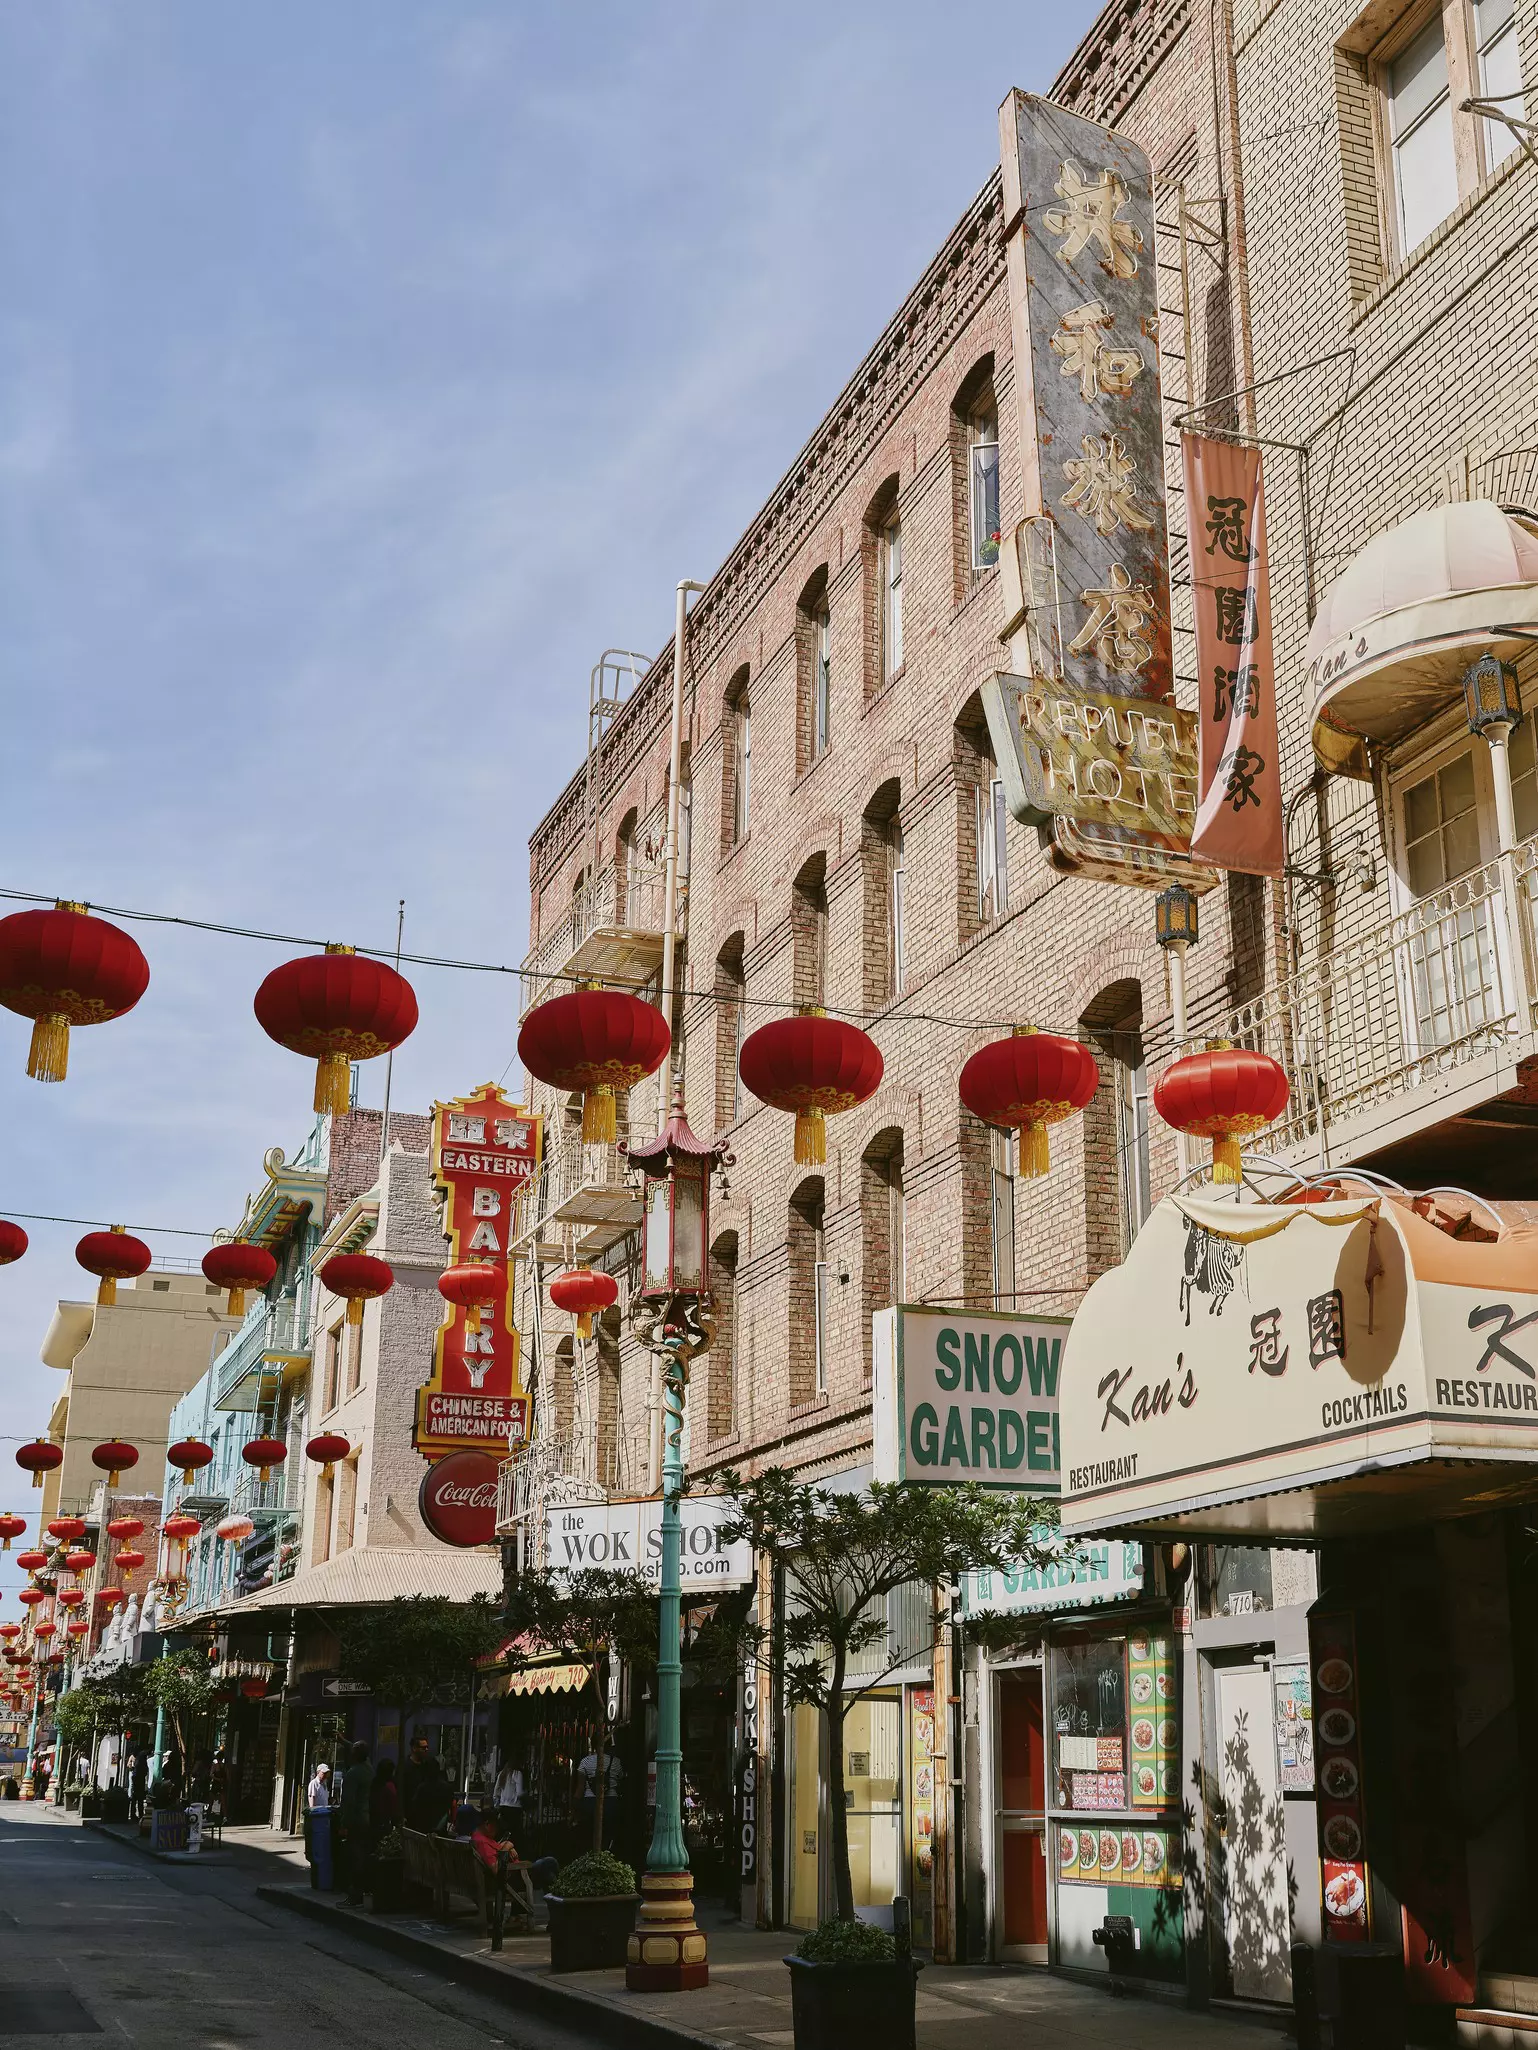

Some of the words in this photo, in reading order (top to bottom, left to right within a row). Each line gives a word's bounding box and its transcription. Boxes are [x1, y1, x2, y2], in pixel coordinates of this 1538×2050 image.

[1021, 693, 1199, 756] REPUBLI
[1041, 747, 1199, 813] HOTE
[443, 1152, 531, 1176] EASTERN
[462, 1187, 501, 1388] BARY
[1247, 1289, 1347, 1376] 冠園
[935, 1328, 1062, 1397] SNOW
[430, 1397, 505, 1417] CHINESE
[509, 1402, 521, 1418] &
[1097, 1351, 1199, 1432] Kan's
[1321, 1384, 1408, 1429] COCKTAILS
[430, 1417, 490, 1436] AMERICAN
[490, 1420, 523, 1437] FOOD
[911, 1402, 1060, 1471] GARDE
[1069, 1453, 1139, 1491] RESTAURANT
[562, 1513, 584, 1531] the
[562, 1531, 631, 1563] WOK
[1232, 1596, 1251, 1615] 710
[338, 1683, 352, 1691] ONE
[568, 1666, 584, 1685] 720
[741, 1769, 757, 1876] SHOP
